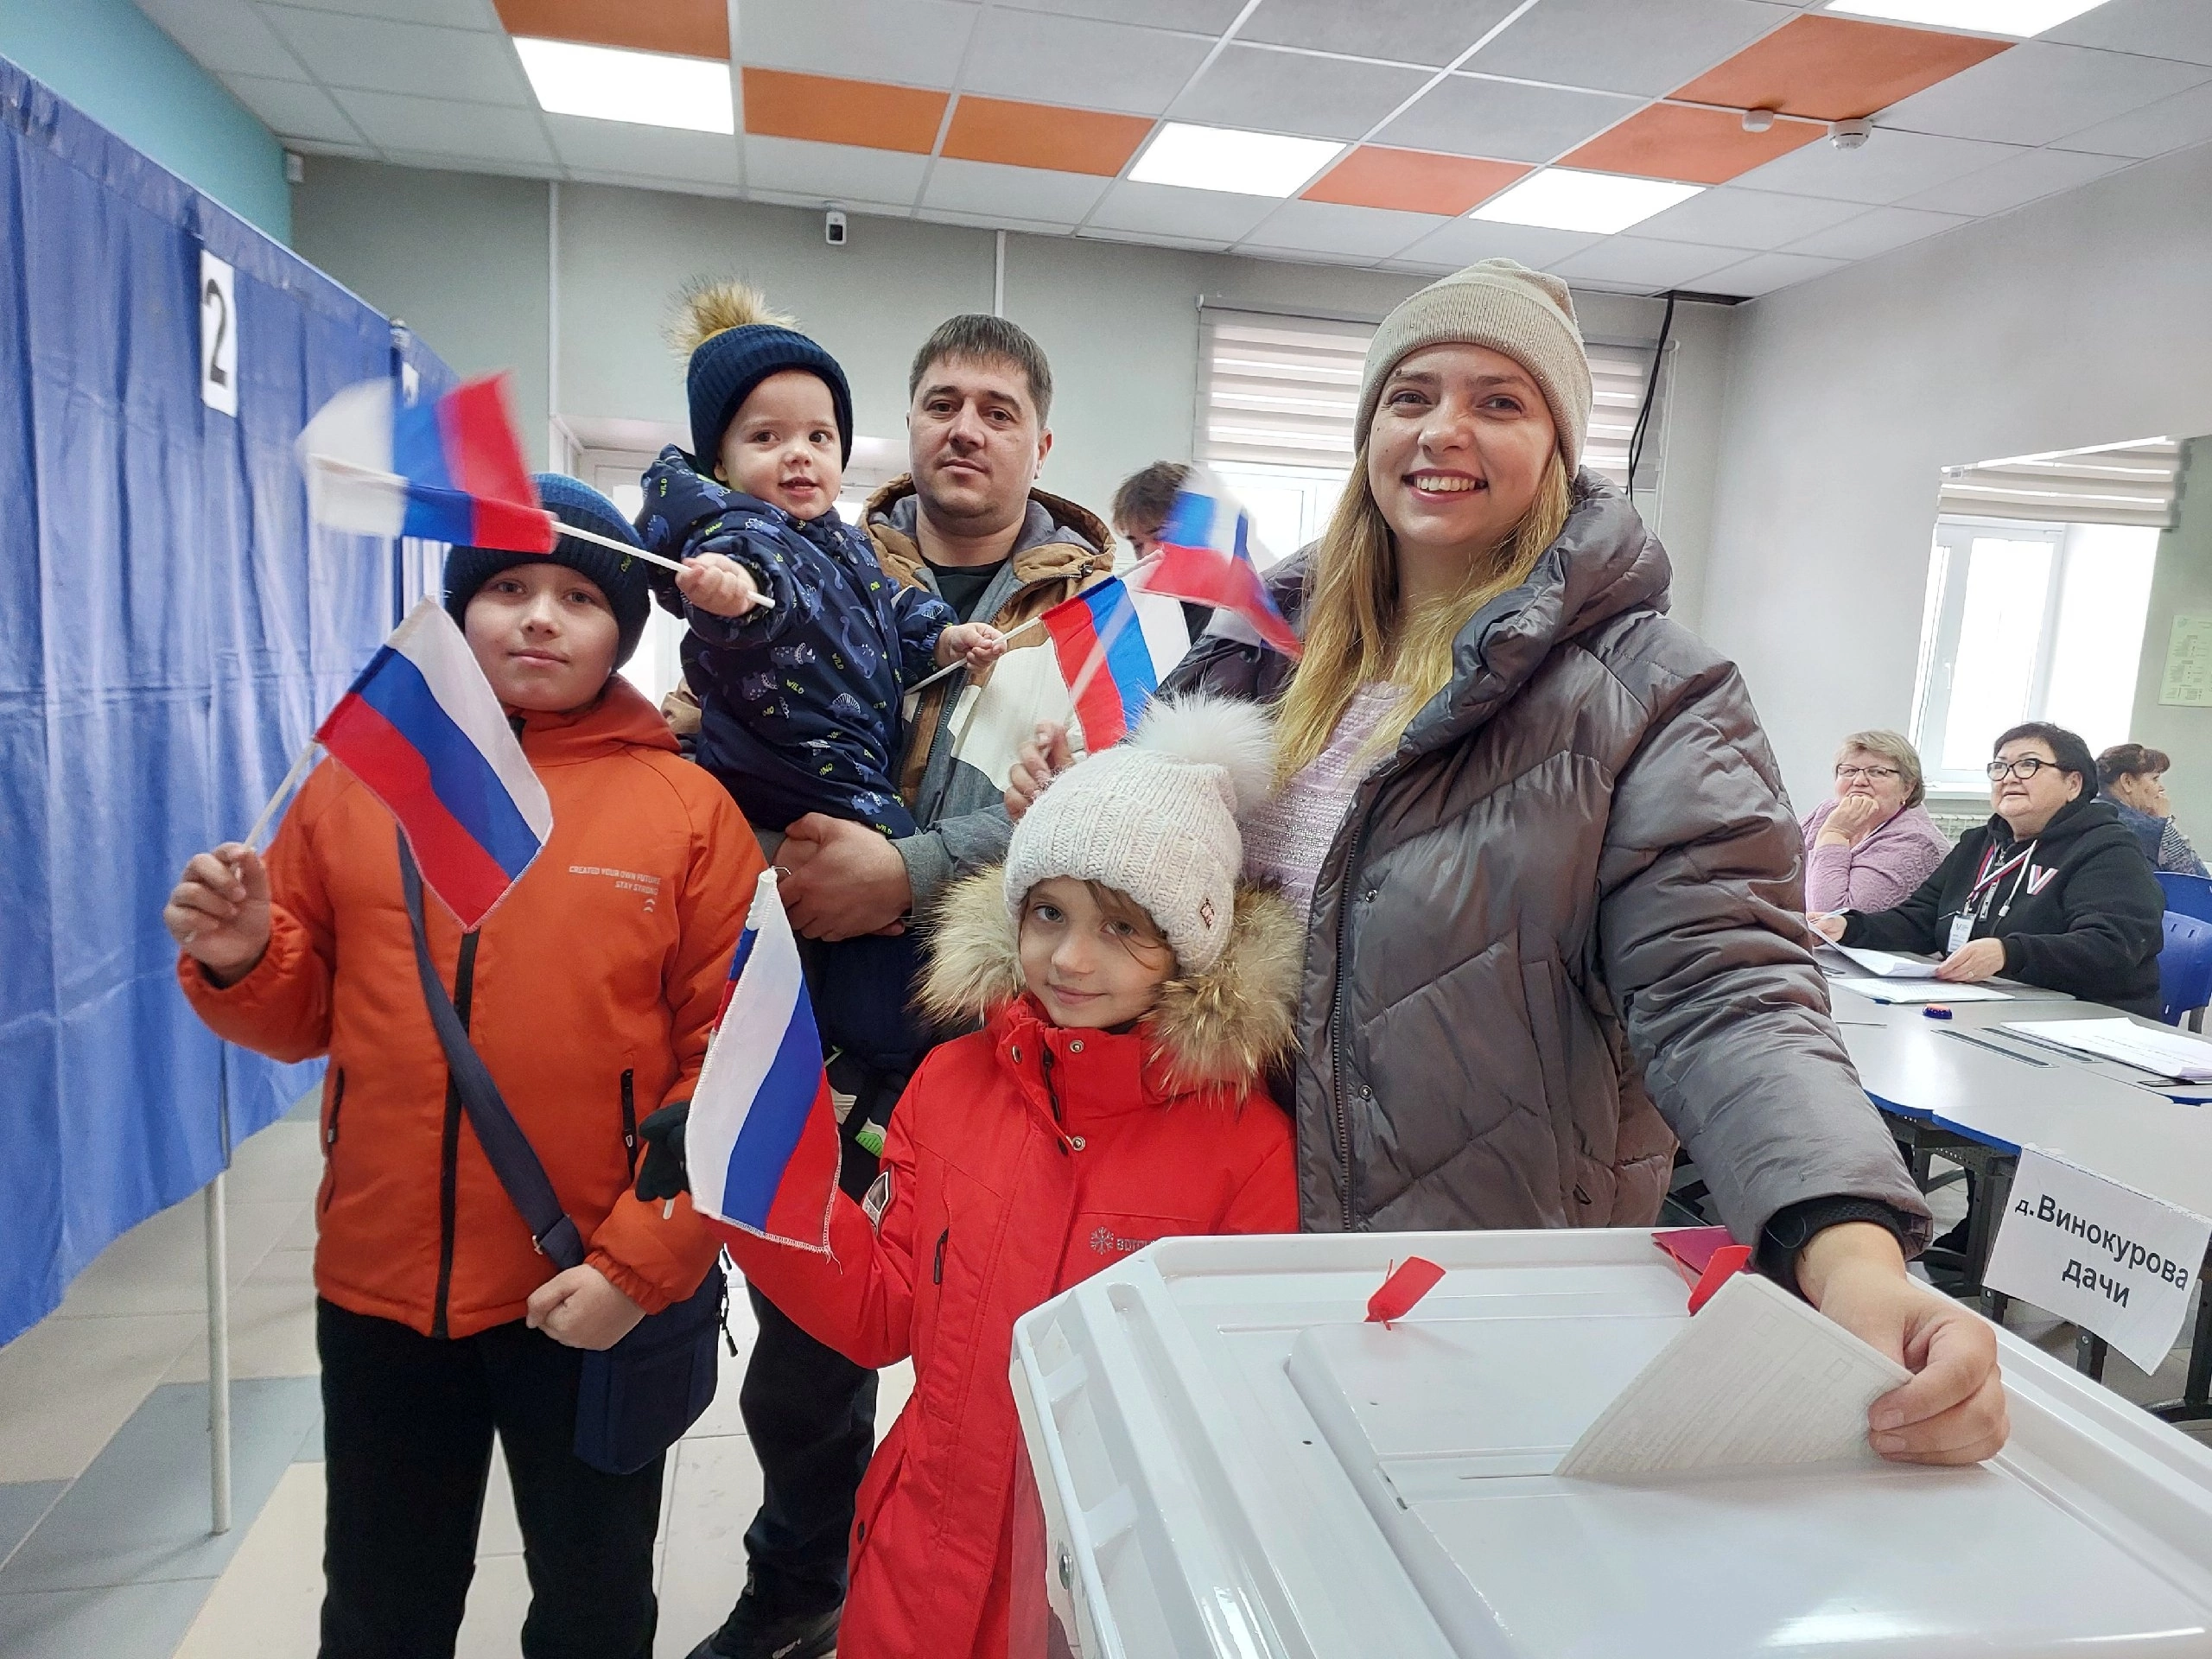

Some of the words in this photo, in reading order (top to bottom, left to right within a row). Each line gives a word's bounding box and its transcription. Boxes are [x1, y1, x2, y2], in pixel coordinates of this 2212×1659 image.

[204, 279, 228, 387] 2
[786, 679, 804, 695] WILD
[875, 823, 892, 835] WILD
[601, 868, 619, 877] YOUR
[620, 870, 636, 880] OWN
[637, 873, 661, 884] FUTURE
[615, 880, 632, 890] STAY
[633, 883, 658, 895] STRONG
[2014, 1193, 2189, 1291] д.Винокурова
[2062, 1258, 2130, 1308] дачи
